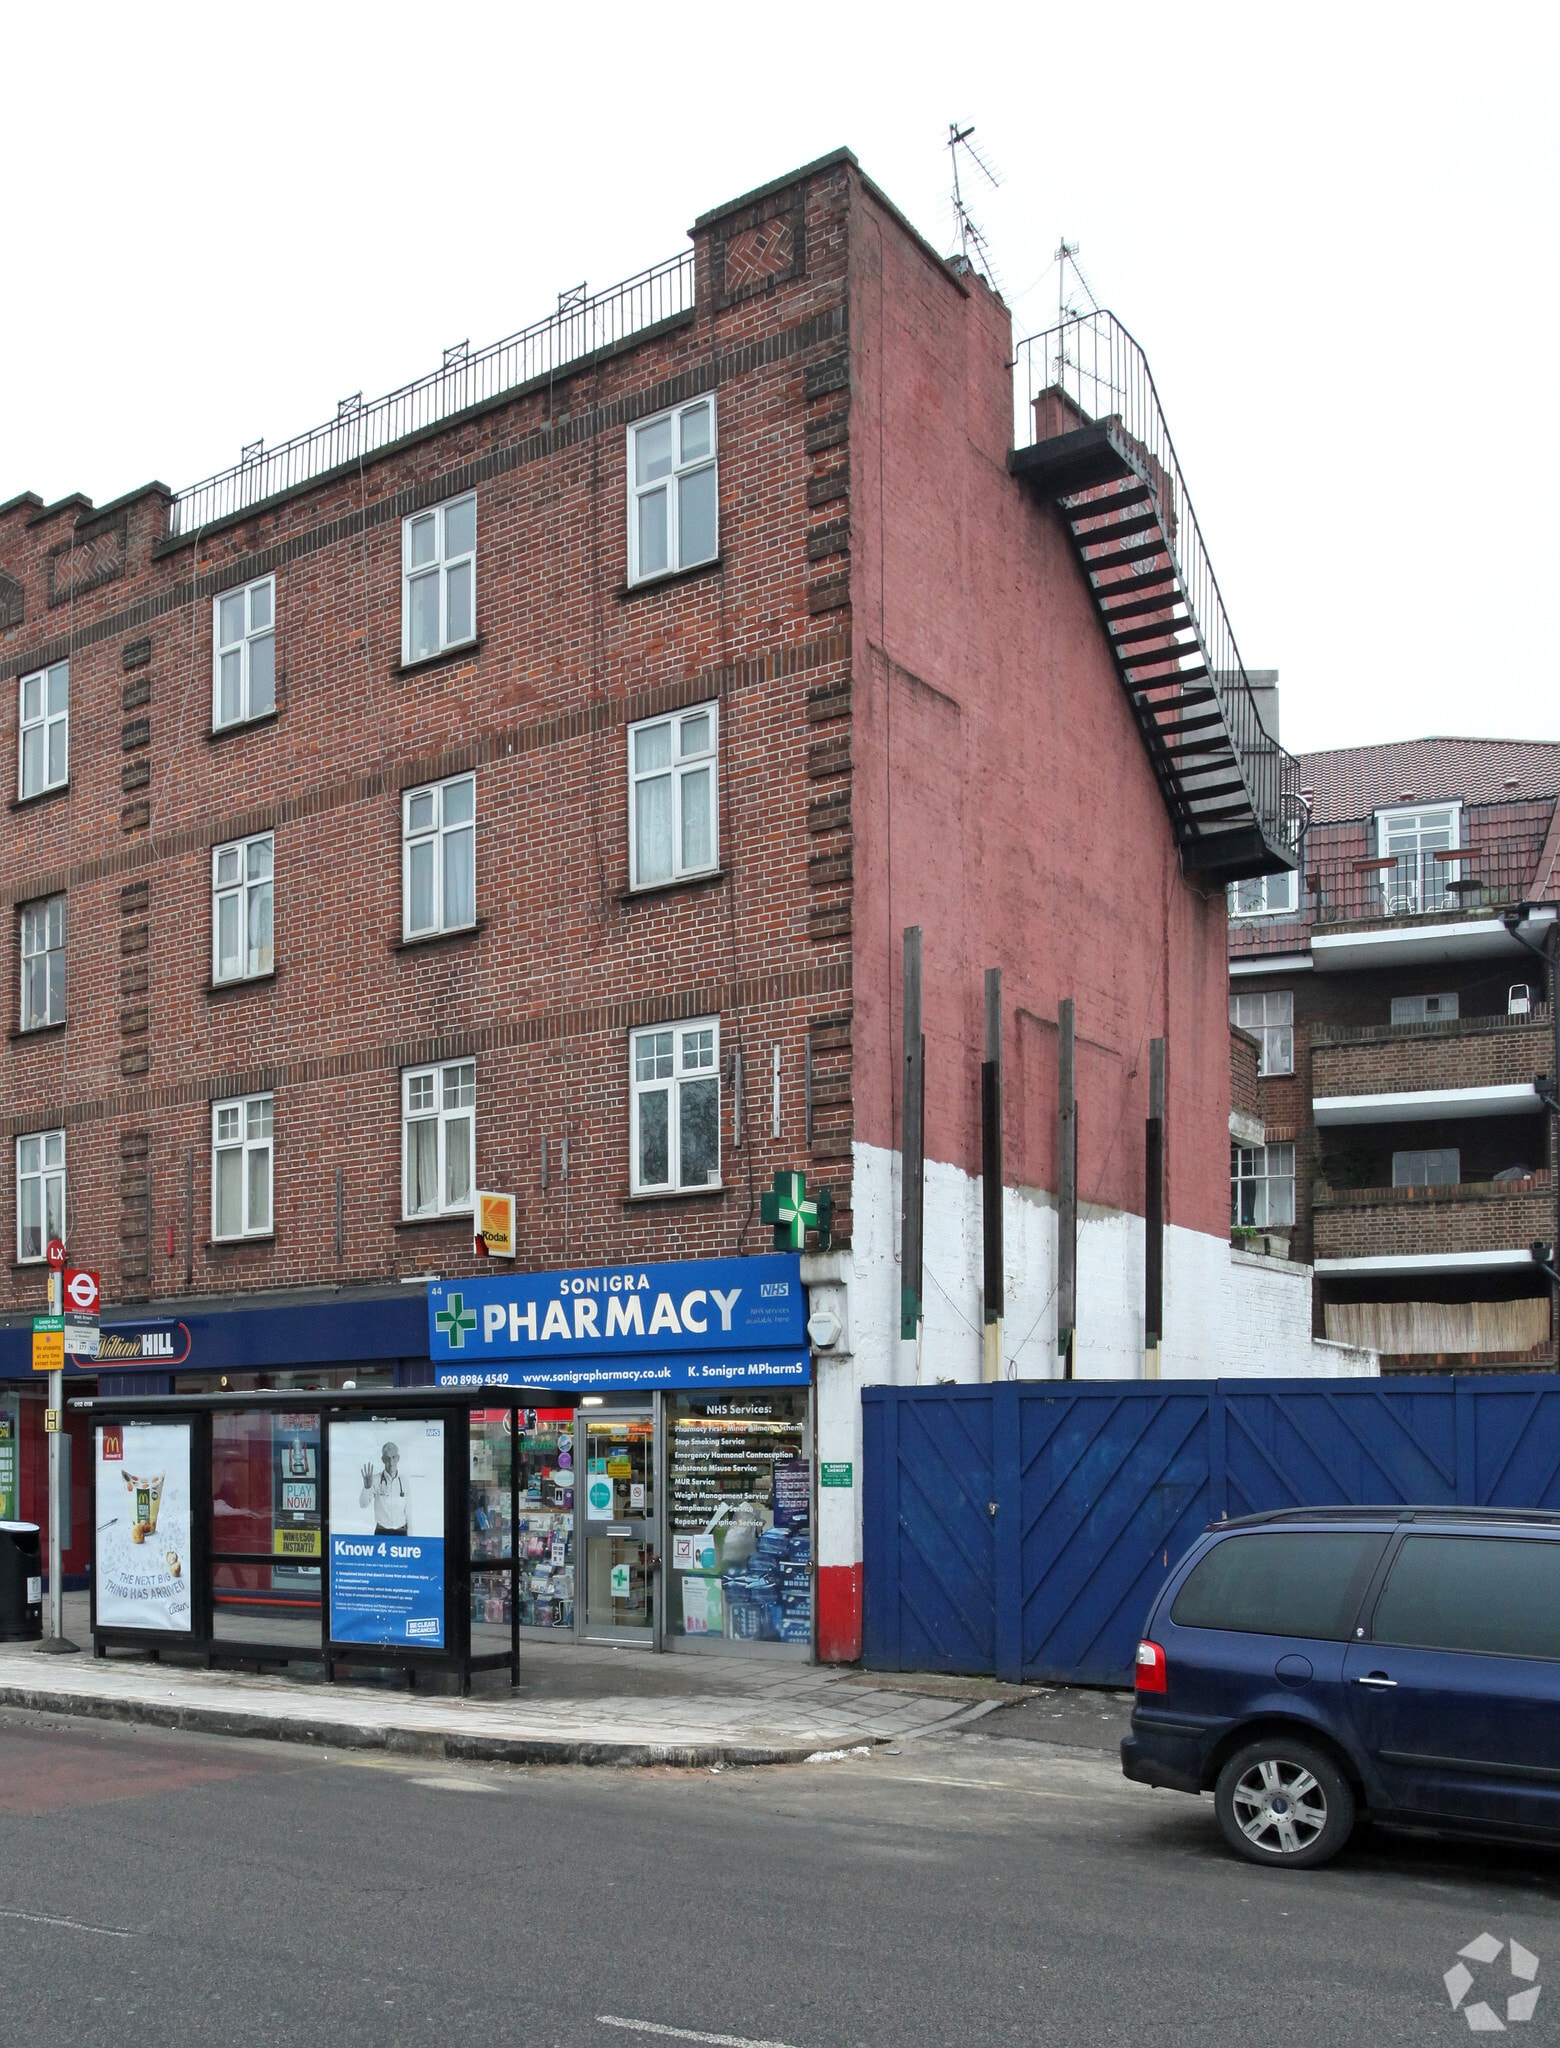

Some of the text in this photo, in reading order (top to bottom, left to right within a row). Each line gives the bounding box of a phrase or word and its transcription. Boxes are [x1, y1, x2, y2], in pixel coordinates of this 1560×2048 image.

[482, 1230, 509, 1243] Kodak
[50, 1247, 64, 1261] LX
[559, 1273, 651, 1296] SONIGRA
[762, 1284, 788, 1297] NHS
[431, 1287, 443, 1296] 44
[482, 1288, 743, 1344] PHARMACY
[750, 1307, 764, 1315] NHS
[745, 1317, 772, 1325] available
[95, 1332, 174, 1359] William HILL
[522, 1366, 672, 1384] www.sonigrapharmacy.co.uk
[687, 1362, 803, 1378] K. Sonigra MPharmS
[440, 1372, 509, 1386] 020 8986 4549
[706, 1404, 772, 1415] NHS Services:
[426, 1429, 440, 1437] NHS
[674, 1425, 708, 1434] Pharmacy
[727, 1424, 747, 1432] Minor
[779, 1423, 806, 1431] Scheme
[674, 1437, 746, 1447] Stop Smoking Service
[674, 1450, 794, 1461] Emergency Hormonal Contraception
[674, 1464, 758, 1472] Substance Misuse Service
[691, 1478, 716, 1486] Service
[286, 1484, 312, 1497] PLAY
[674, 1491, 769, 1500] Weight Management Service
[286, 1496, 312, 1509] NOW!
[674, 1504, 712, 1513] Compliance
[729, 1504, 754, 1512] Service
[674, 1518, 763, 1527] Repeat Preription Service
[334, 1540, 422, 1559] Know 4 sure
[120, 1572, 171, 1586] THE NEXT BIG
[104, 1579, 185, 1600] THING HAS ARRIVED
